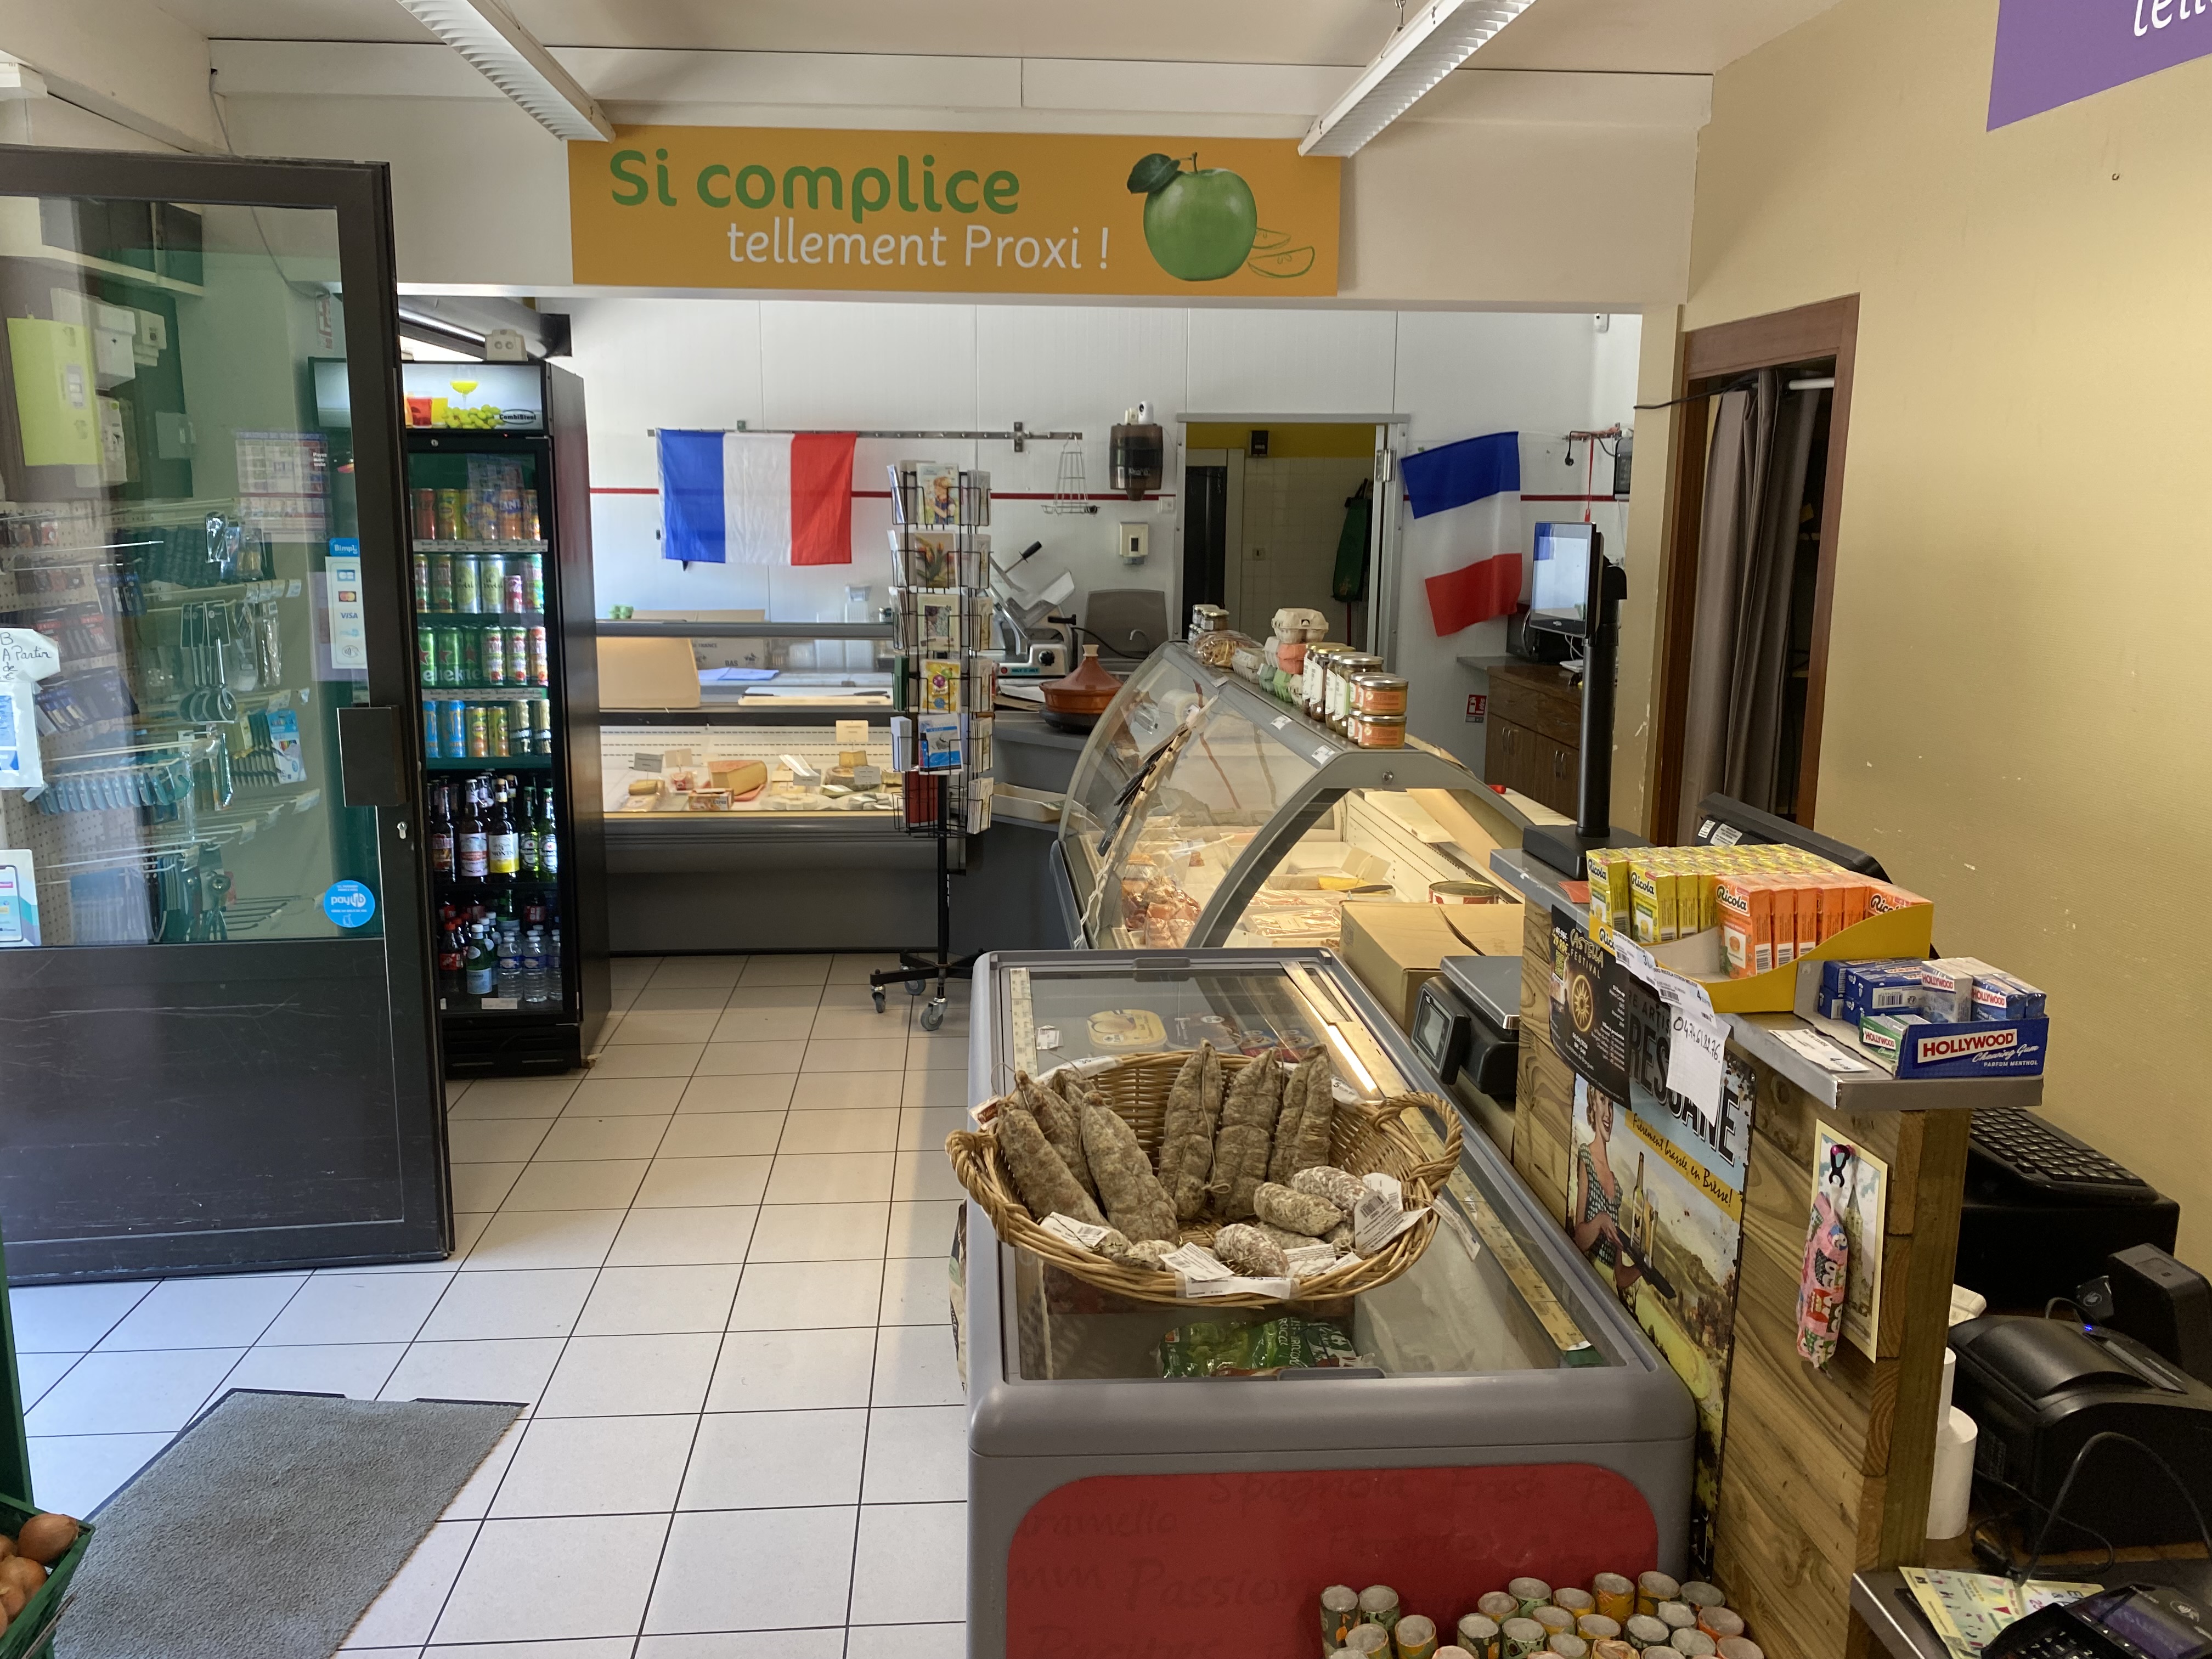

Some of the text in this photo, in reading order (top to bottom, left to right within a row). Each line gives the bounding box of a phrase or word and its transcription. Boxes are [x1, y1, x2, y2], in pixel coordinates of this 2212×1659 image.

[610, 148, 1020, 223] Si complice
[727, 217, 1109, 269] tellement Proxi !
[1588, 859, 1607, 881] Ricola
[1630, 872, 1655, 895] Ricola
[1717, 885, 1747, 911] Ricola
[1571, 949, 1600, 979] FESTIVAL
[1921, 974, 1954, 990] HOLLYWOOD
[1972, 986, 2005, 1007] HOLLYWOOD
[1864, 1030, 1895, 1048] HOLLYWOOD
[1922, 1032, 2014, 1058] HOLLYWOOD
[1972, 1044, 2039, 1063] Chewing Gum
